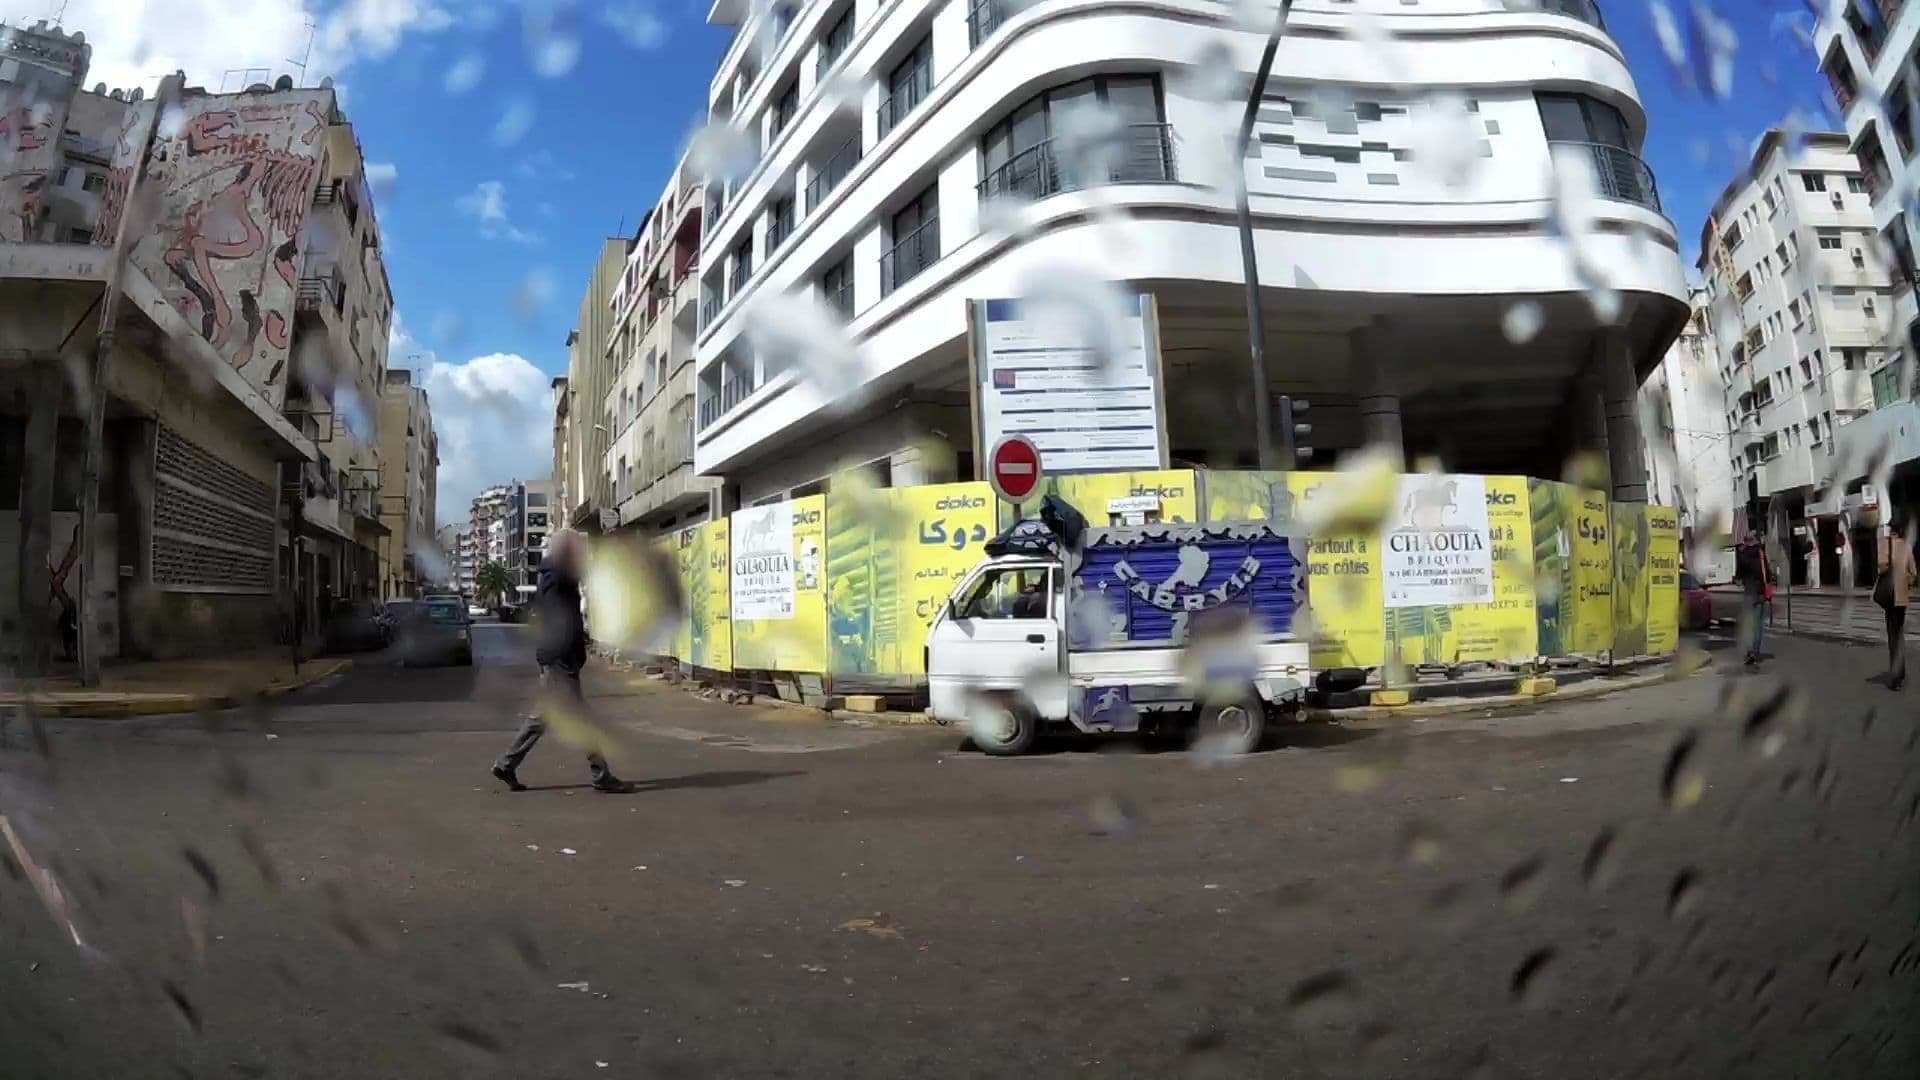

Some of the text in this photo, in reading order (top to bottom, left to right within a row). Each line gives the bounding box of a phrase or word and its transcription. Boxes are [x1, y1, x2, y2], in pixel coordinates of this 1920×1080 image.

[1131, 484, 1184, 498] doka
[936, 495, 986, 510] doka
[919, 519, 986, 551] دوكا
[1390, 533, 1483, 552] CHAOUIA
[1305, 536, 1354, 554] Partout
